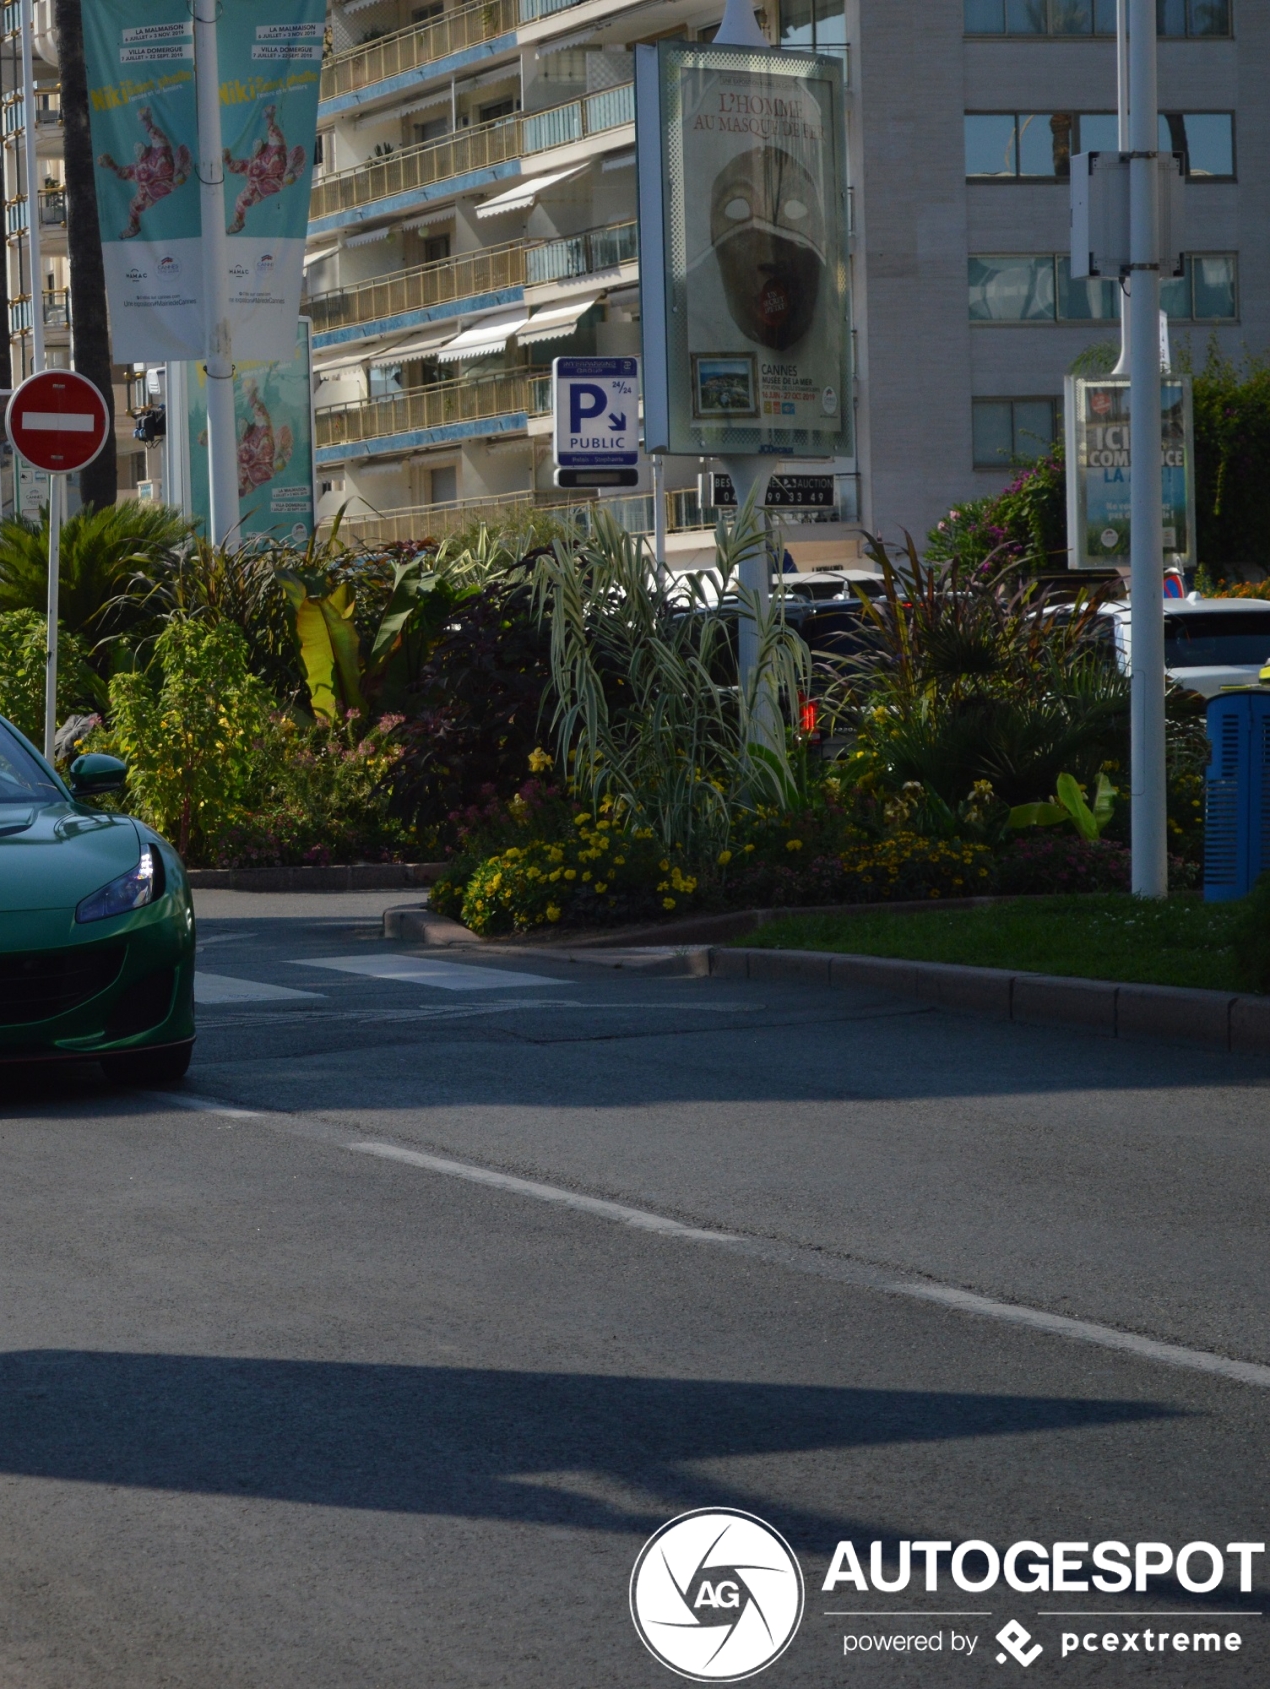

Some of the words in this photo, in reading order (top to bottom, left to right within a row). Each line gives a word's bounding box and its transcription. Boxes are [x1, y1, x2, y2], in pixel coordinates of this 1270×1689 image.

[144, 24, 184, 34] MALMAISON
[130, 34, 148, 42] JUILLET
[146, 46, 183, 54] DOMERGUE
[90, 80, 129, 111] Niki
[718, 93, 804, 119] L'HOMME
[693, 114, 716, 130] AU
[718, 116, 779, 140] MASQUE
[782, 120, 800, 138] DE
[762, 364, 798, 376] CANNES
[762, 376, 781, 384] MUSÉE
[800, 378, 813, 386] MER
[612, 381, 632, 394] 24/24
[784, 392, 791, 400] 27
[802, 392, 816, 400] 2019
[570, 384, 608, 434] P
[570, 438, 624, 448] PUBLIC
[1096, 426, 1130, 450] ICI
[1104, 468, 1124, 482] LA
[798, 478, 833, 488] AUCTION
